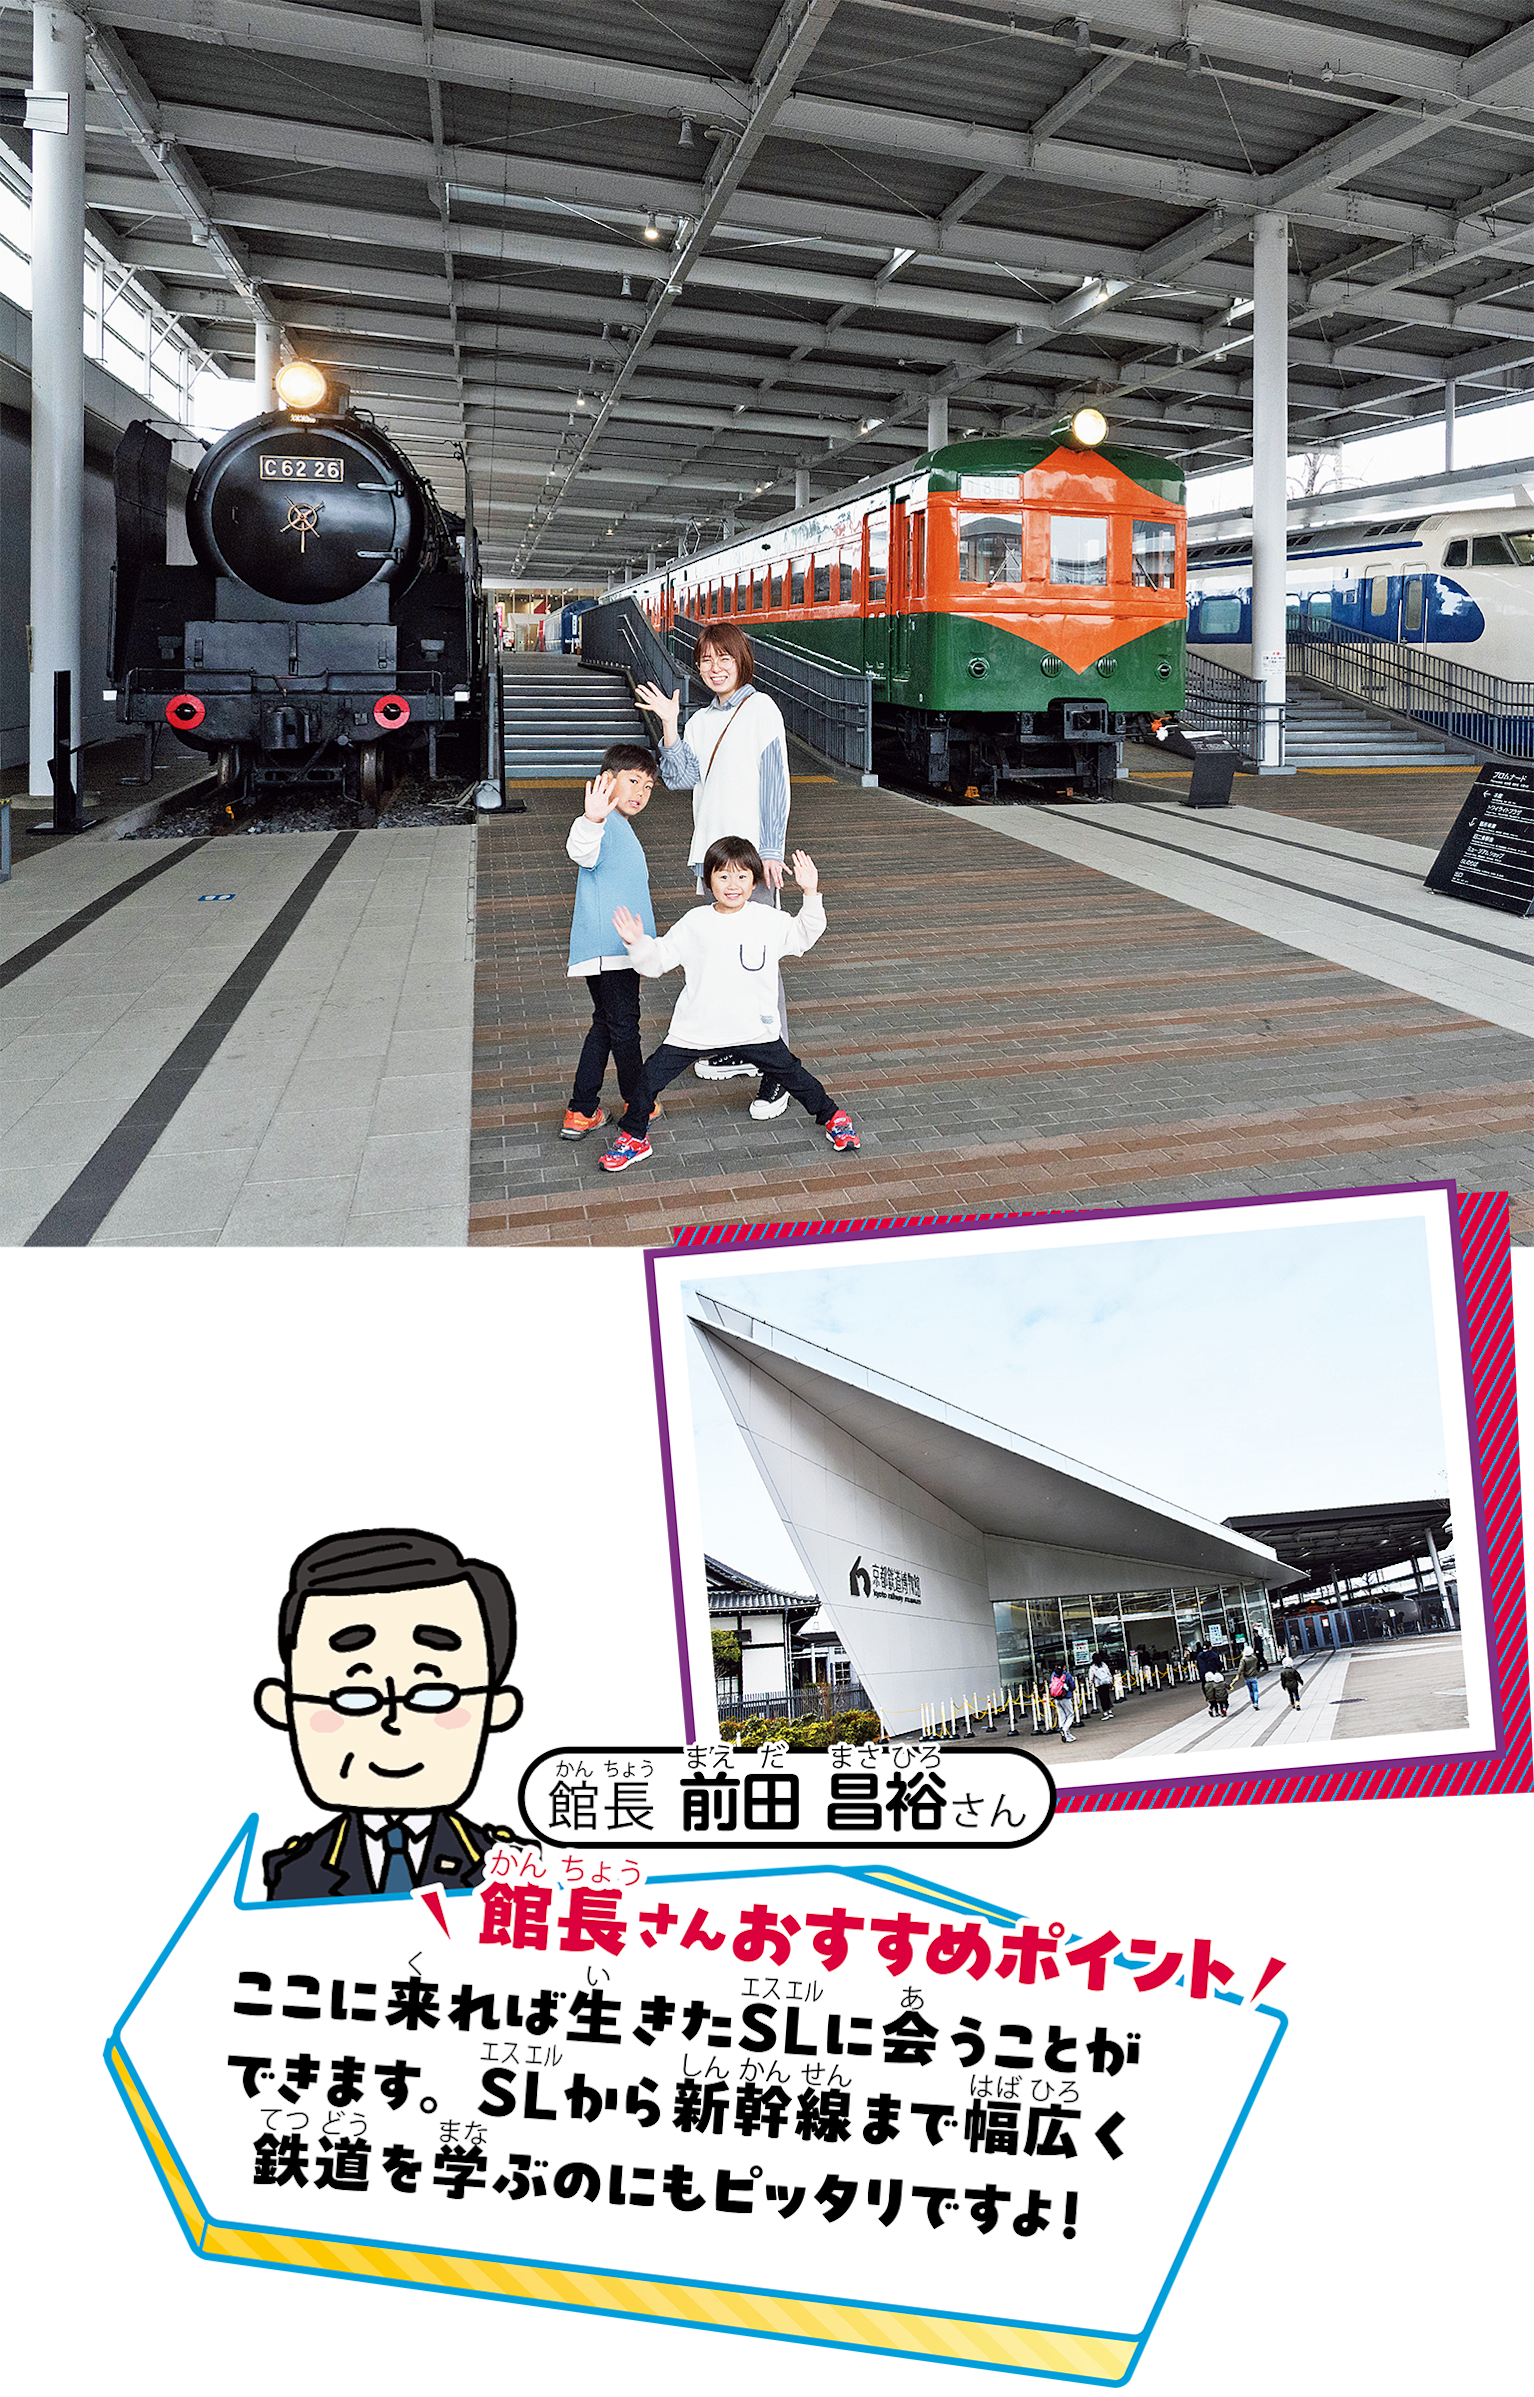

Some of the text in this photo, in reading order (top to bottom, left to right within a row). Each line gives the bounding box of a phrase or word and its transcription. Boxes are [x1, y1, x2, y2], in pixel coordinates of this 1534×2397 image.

[314, 461, 340, 479] 26
[1493, 771, 1528, 782] プロムナード
